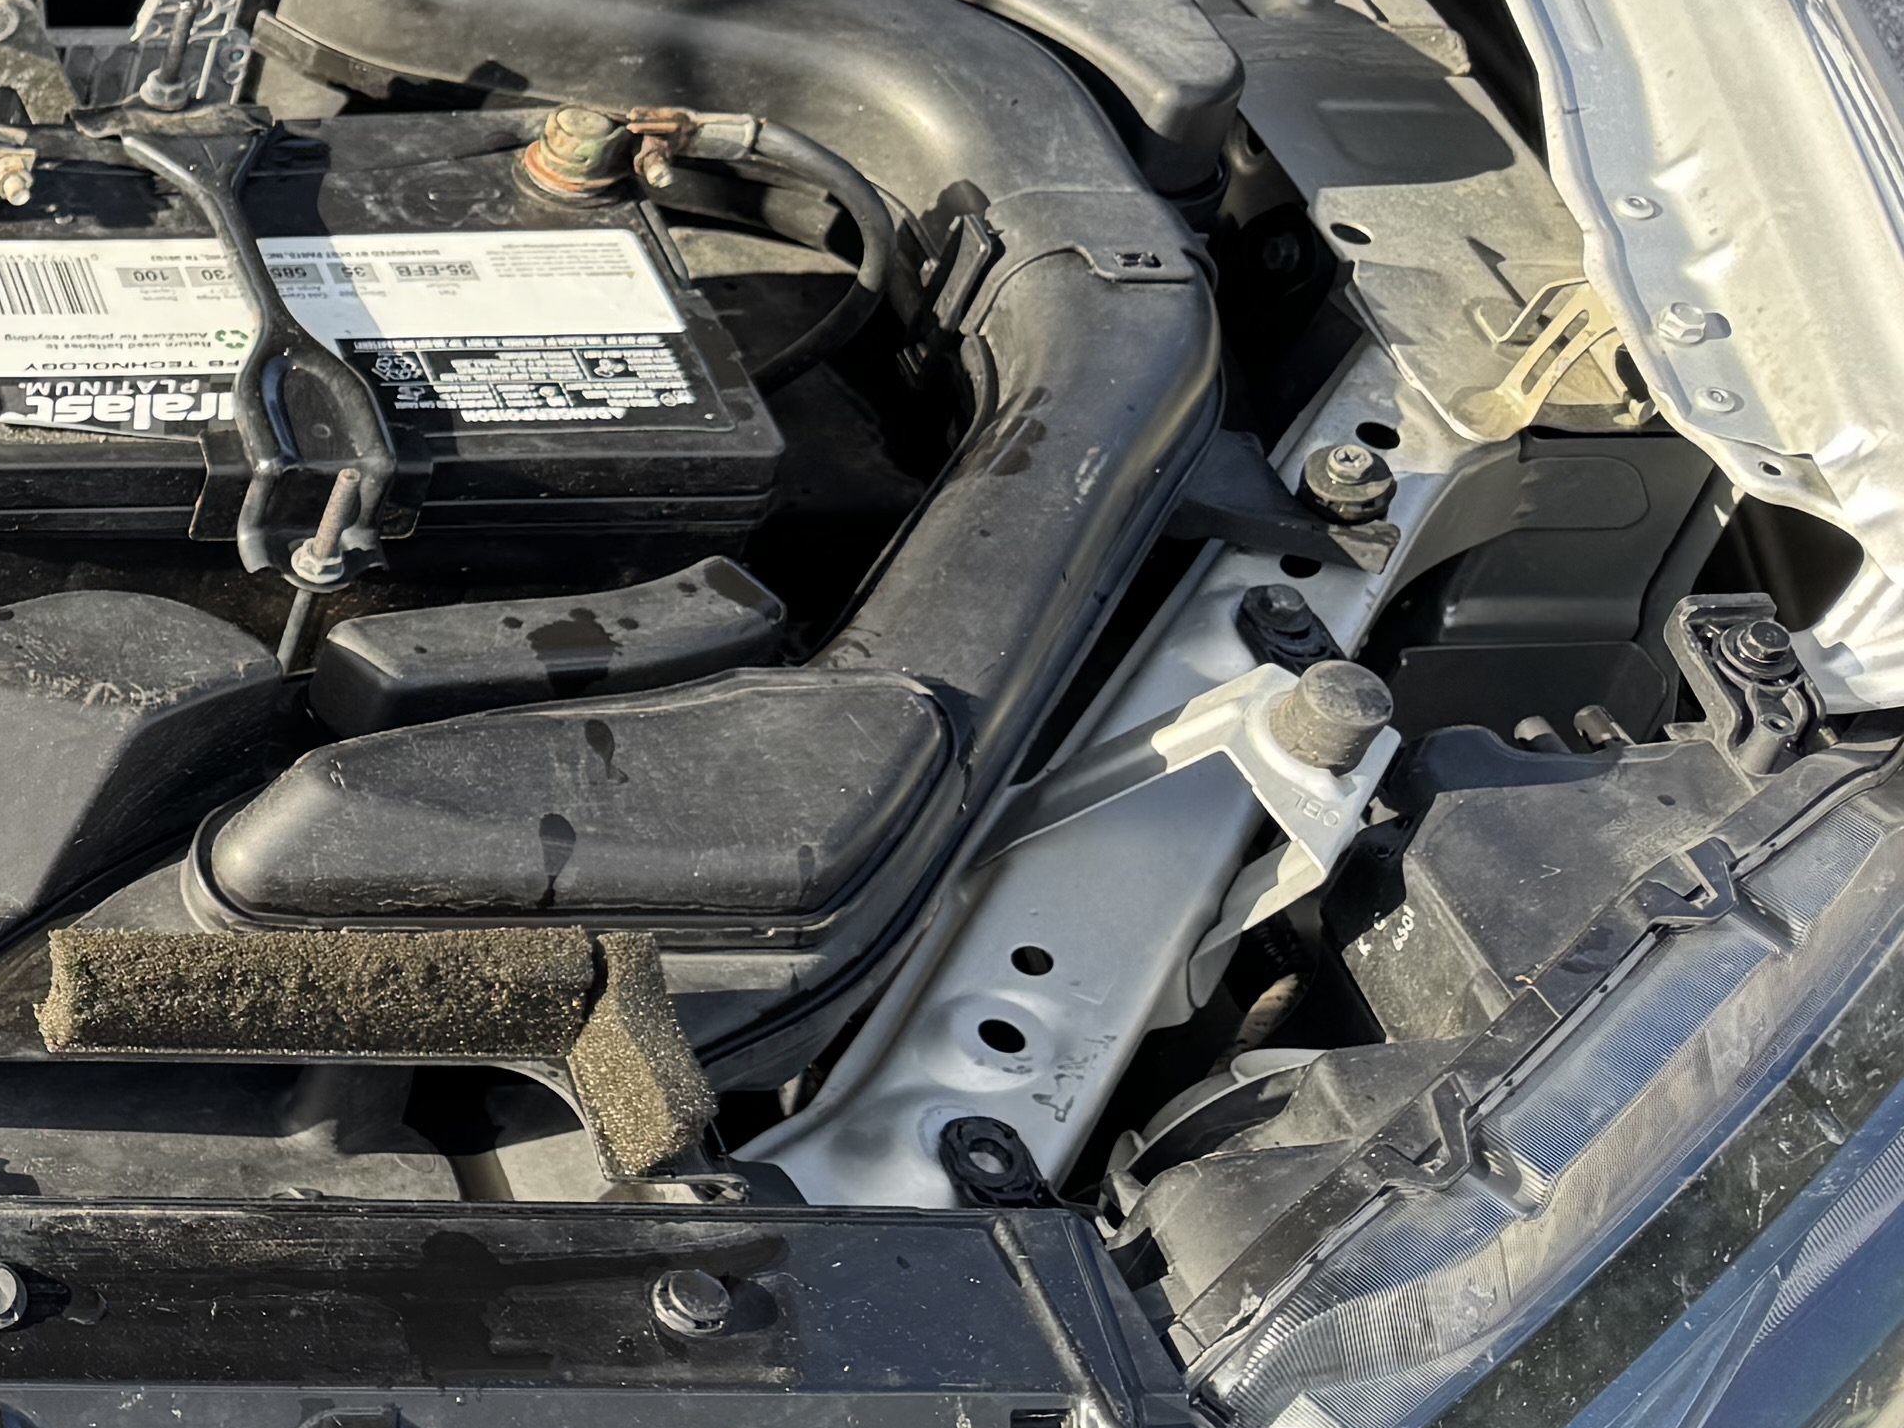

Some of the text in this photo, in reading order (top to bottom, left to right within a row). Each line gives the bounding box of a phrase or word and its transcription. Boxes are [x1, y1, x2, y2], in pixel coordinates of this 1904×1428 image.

[133, 269, 169, 282] 100
[201, 269, 235, 280] 30
[341, 265, 366, 278] 35
[395, 264, 472, 277] 35-EFB
[143, 332, 208, 341] AutoZone
[63, 340, 123, 350] batteries
[128, 340, 160, 350] used
[165, 340, 211, 350] Return
[24, 359, 240, 372] FB TECHNOLOGY
[25, 392, 235, 431] ralast
